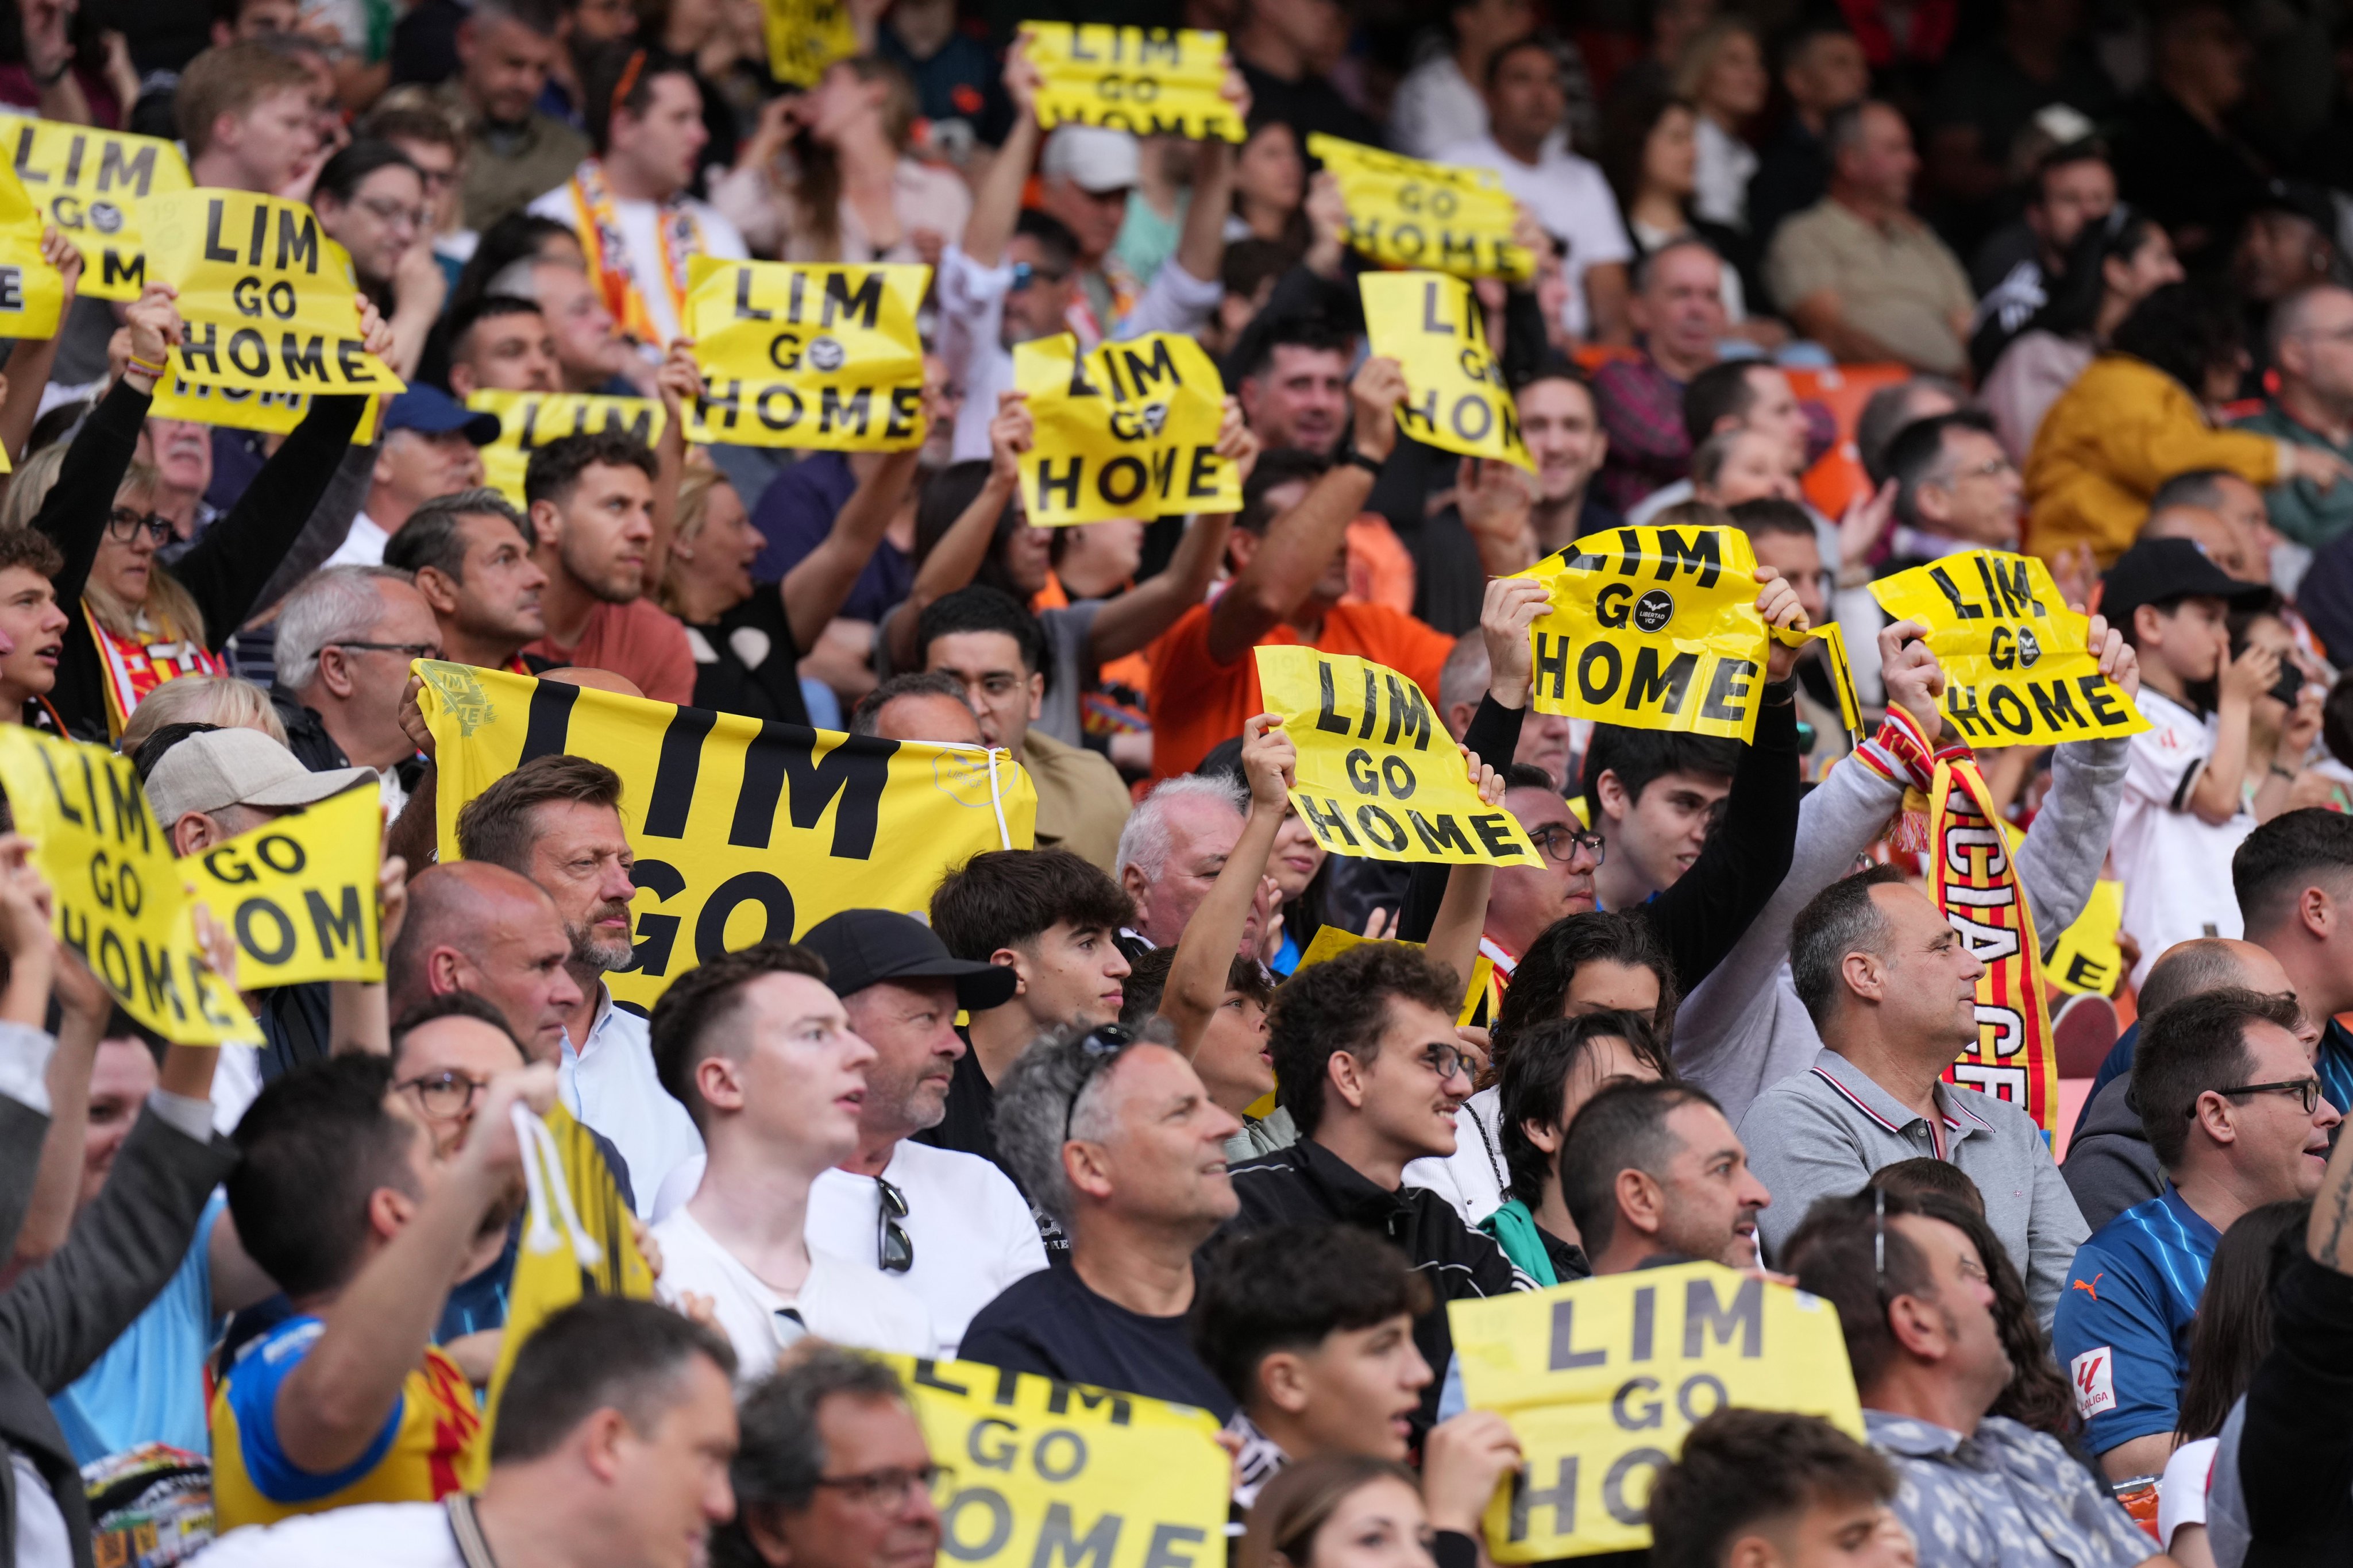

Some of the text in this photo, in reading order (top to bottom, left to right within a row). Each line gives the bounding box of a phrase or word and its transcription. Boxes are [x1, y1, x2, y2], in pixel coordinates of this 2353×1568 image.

[1096, 73, 1160, 105] GO
[15, 126, 158, 198] LIM
[1397, 183, 1458, 218] GO
[205, 199, 318, 275] LIM
[233, 276, 296, 320] GO
[734, 268, 885, 329] LIM
[180, 321, 377, 383] HOME
[1068, 339, 1182, 402] LIM
[693, 376, 921, 438] HOME
[1559, 528, 1722, 589] LIM
[1929, 557, 2046, 620] LIM
[1639, 611, 1665, 620] LIBERTAD
[1316, 660, 1432, 752] LIM
[1536, 632, 1758, 721] HOME
[1947, 675, 2130, 736] HOME
[37, 742, 150, 855] LIM
[1345, 748, 1417, 800] GO
[1299, 794, 1525, 857] HOME
[91, 849, 142, 917] GO
[203, 834, 306, 885] GO
[234, 885, 383, 966] OM
[608, 859, 796, 977] GO
[1547, 1279, 1764, 1372] LIM
[1611, 1373, 1729, 1431] GO
[2081, 1392, 2108, 1412] LALIGA
[967, 1418, 1089, 1483] GO
[1507, 1447, 1673, 1542] HO
[941, 1486, 1206, 1568] OME
